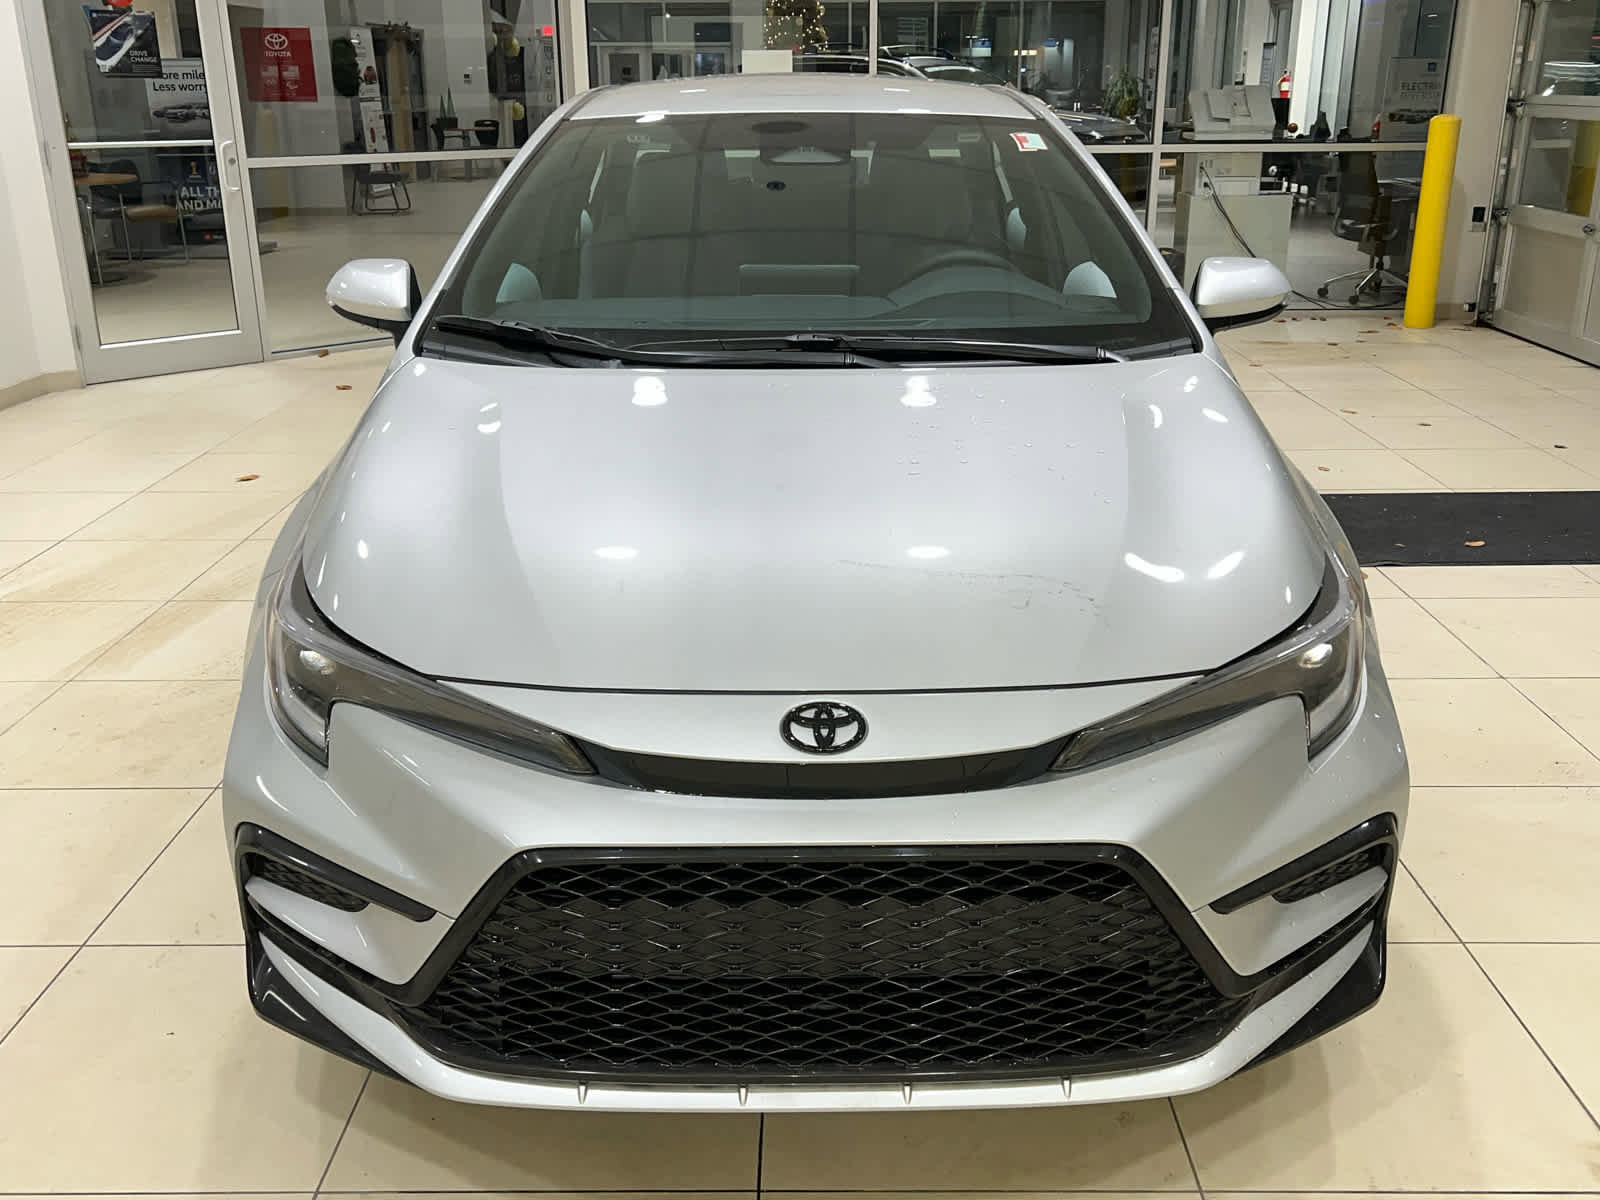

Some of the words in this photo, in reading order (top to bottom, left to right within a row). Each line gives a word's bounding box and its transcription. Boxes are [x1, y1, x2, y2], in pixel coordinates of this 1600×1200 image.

[160, 71, 180, 80] ore
[182, 69, 206, 80] mile
[152, 81, 176, 91] Less
[180, 186, 205, 198] ALL
[176, 199, 204, 210] AND
